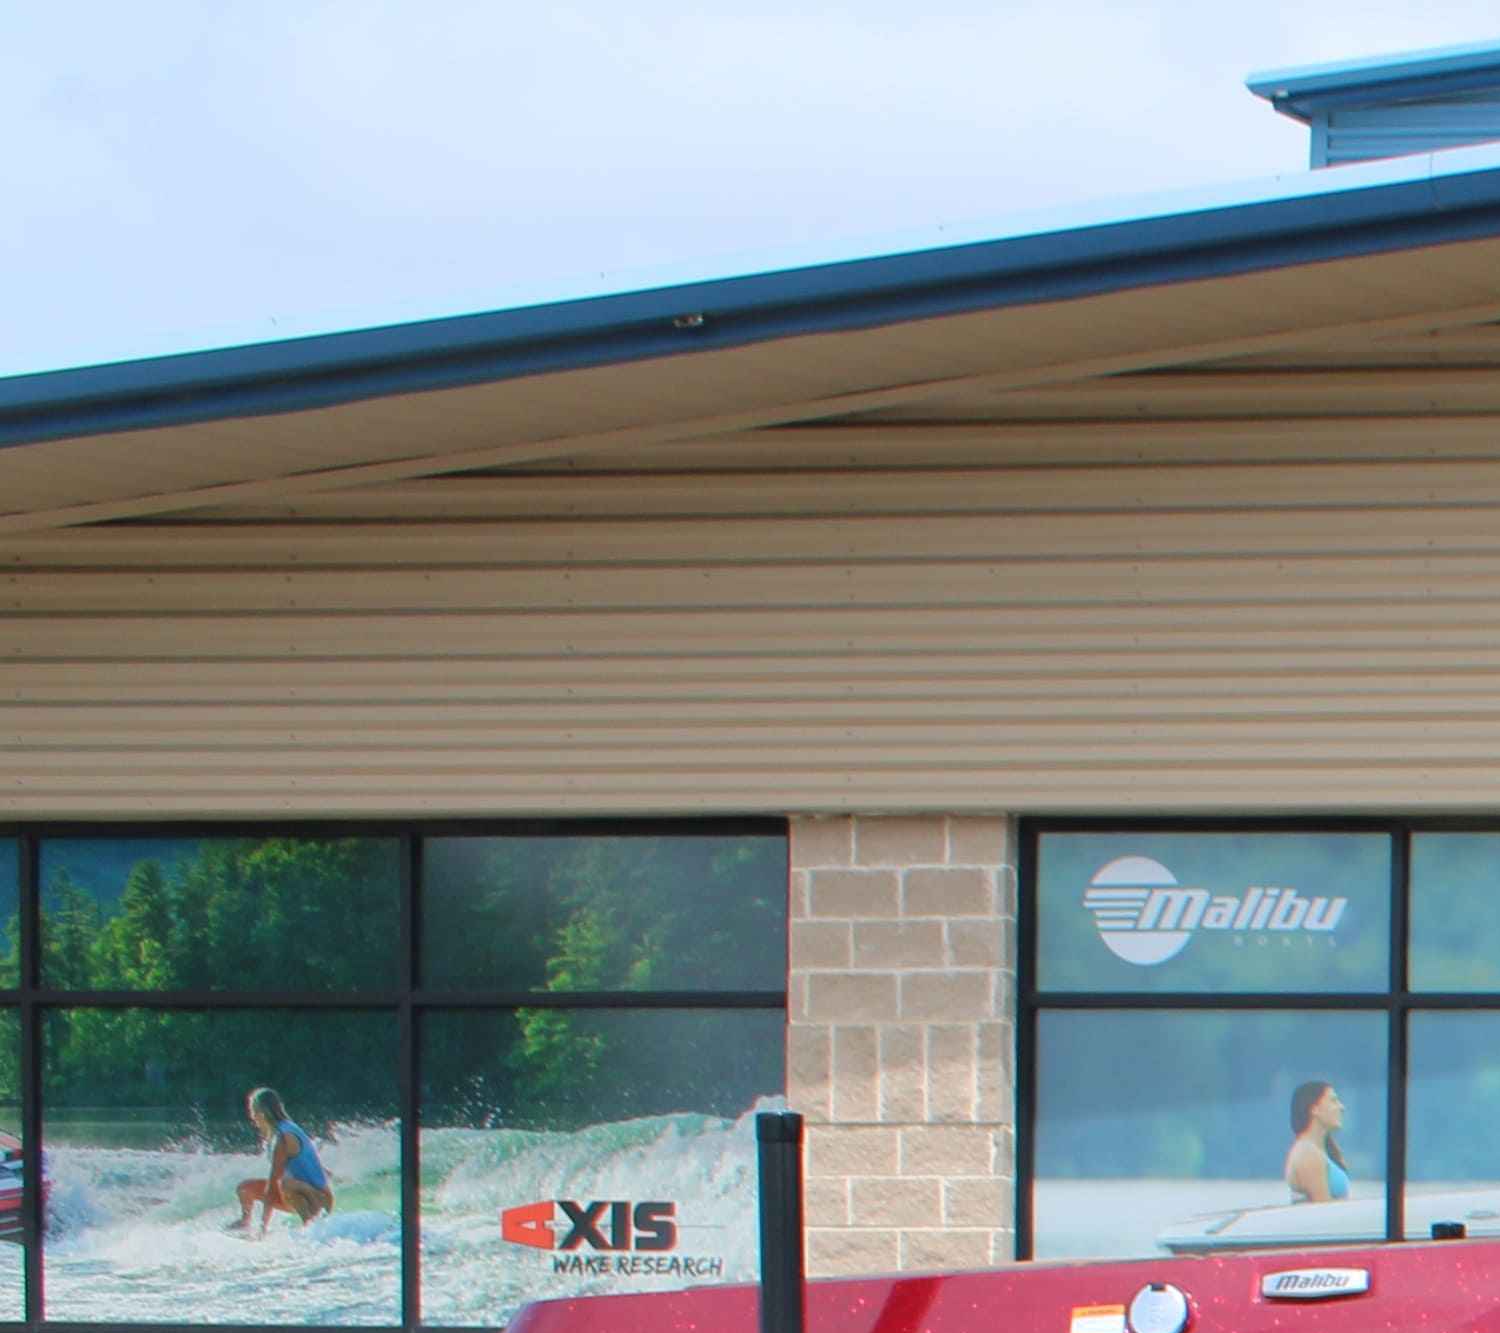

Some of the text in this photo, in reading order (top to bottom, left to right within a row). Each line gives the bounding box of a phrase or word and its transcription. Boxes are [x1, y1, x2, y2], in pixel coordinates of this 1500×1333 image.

[1135, 886, 1348, 931] Malibu
[500, 1199, 678, 1251] AXIS
[552, 1255, 724, 1278] WAKE RESEARCH
[1275, 1272, 1351, 1291] Malibu
